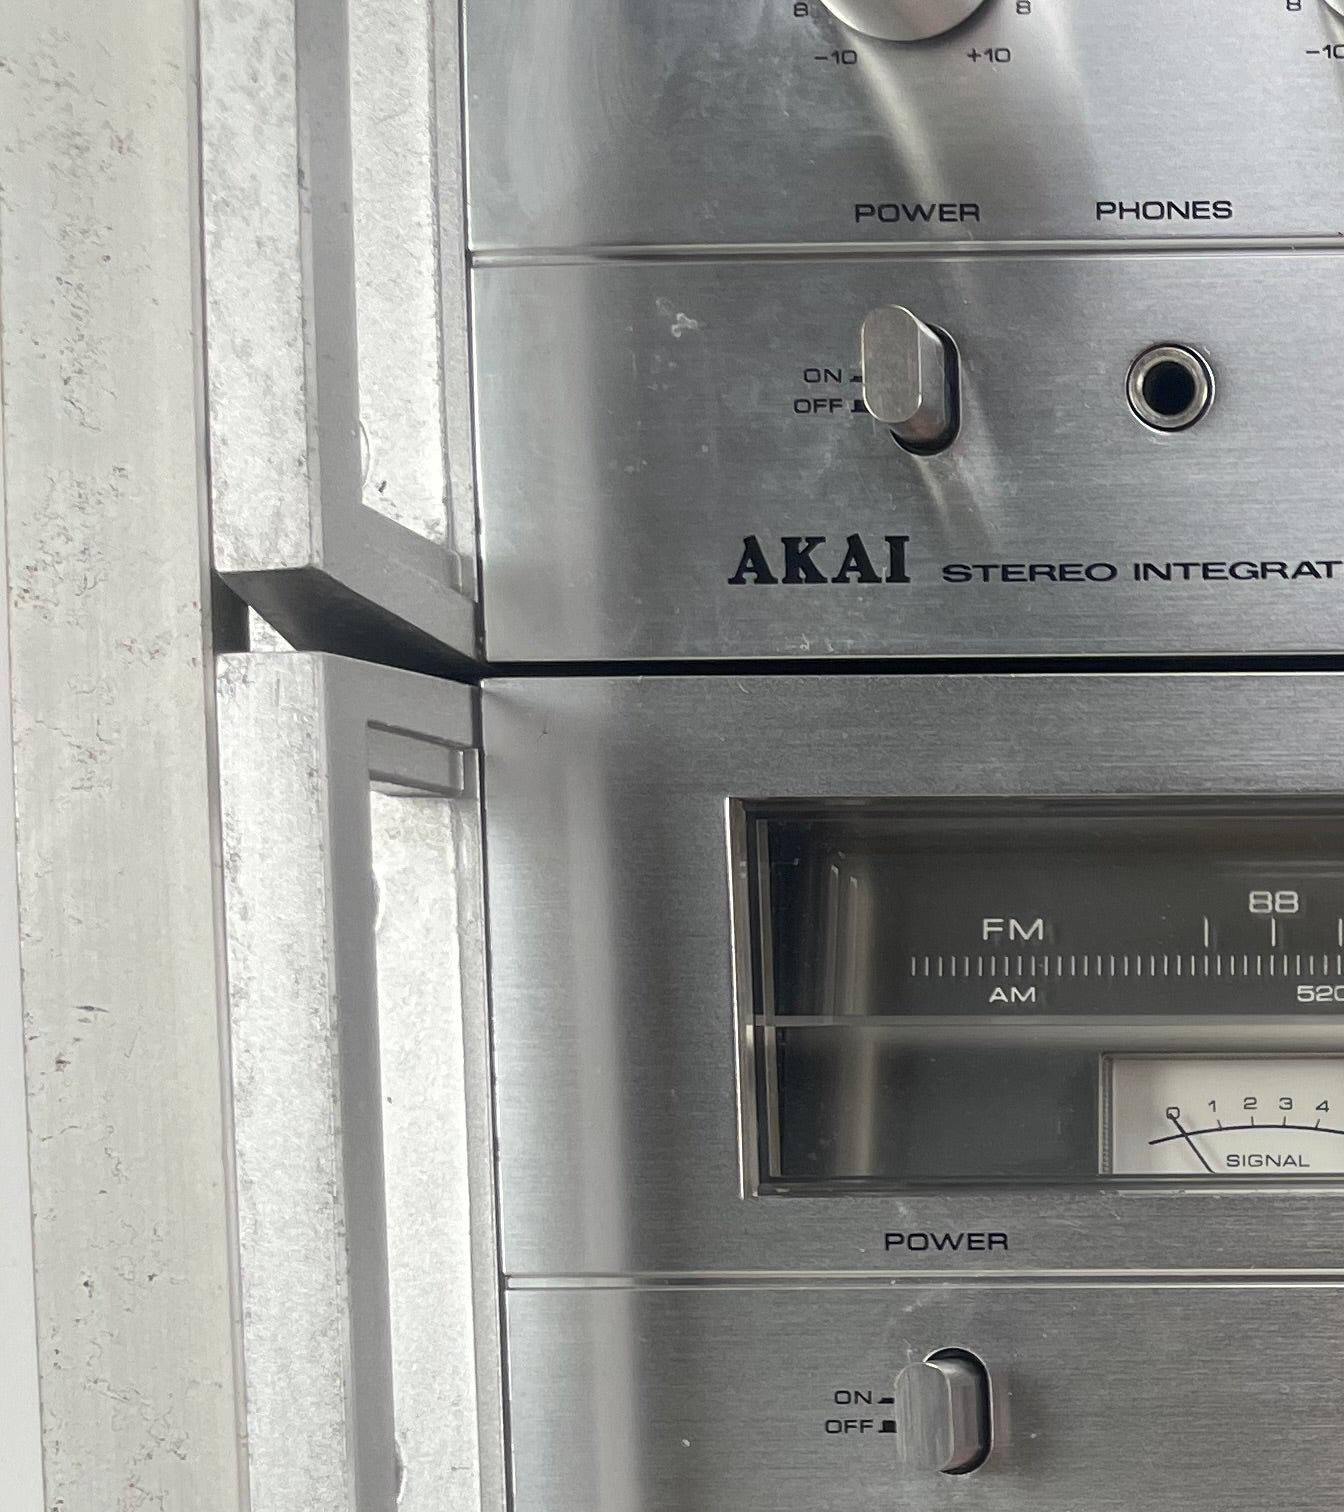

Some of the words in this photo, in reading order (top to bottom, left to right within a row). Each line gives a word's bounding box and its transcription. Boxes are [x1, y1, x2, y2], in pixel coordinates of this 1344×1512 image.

[854, 202, 981, 224] POWER
[1095, 200, 1233, 222] PHONES
[803, 367, 842, 384] ON
[793, 397, 843, 414] OFF
[727, 533, 911, 585] AKAI
[941, 562, 1118, 583] STEREO
[1248, 890, 1299, 914] 88
[982, 918, 1044, 941] FM
[988, 986, 1036, 1003] AM
[1226, 1153, 1311, 1168] SIGNAL
[884, 1232, 1009, 1252] POWER
[834, 1390, 873, 1405] ON
[824, 1419, 874, 1434] OFF
